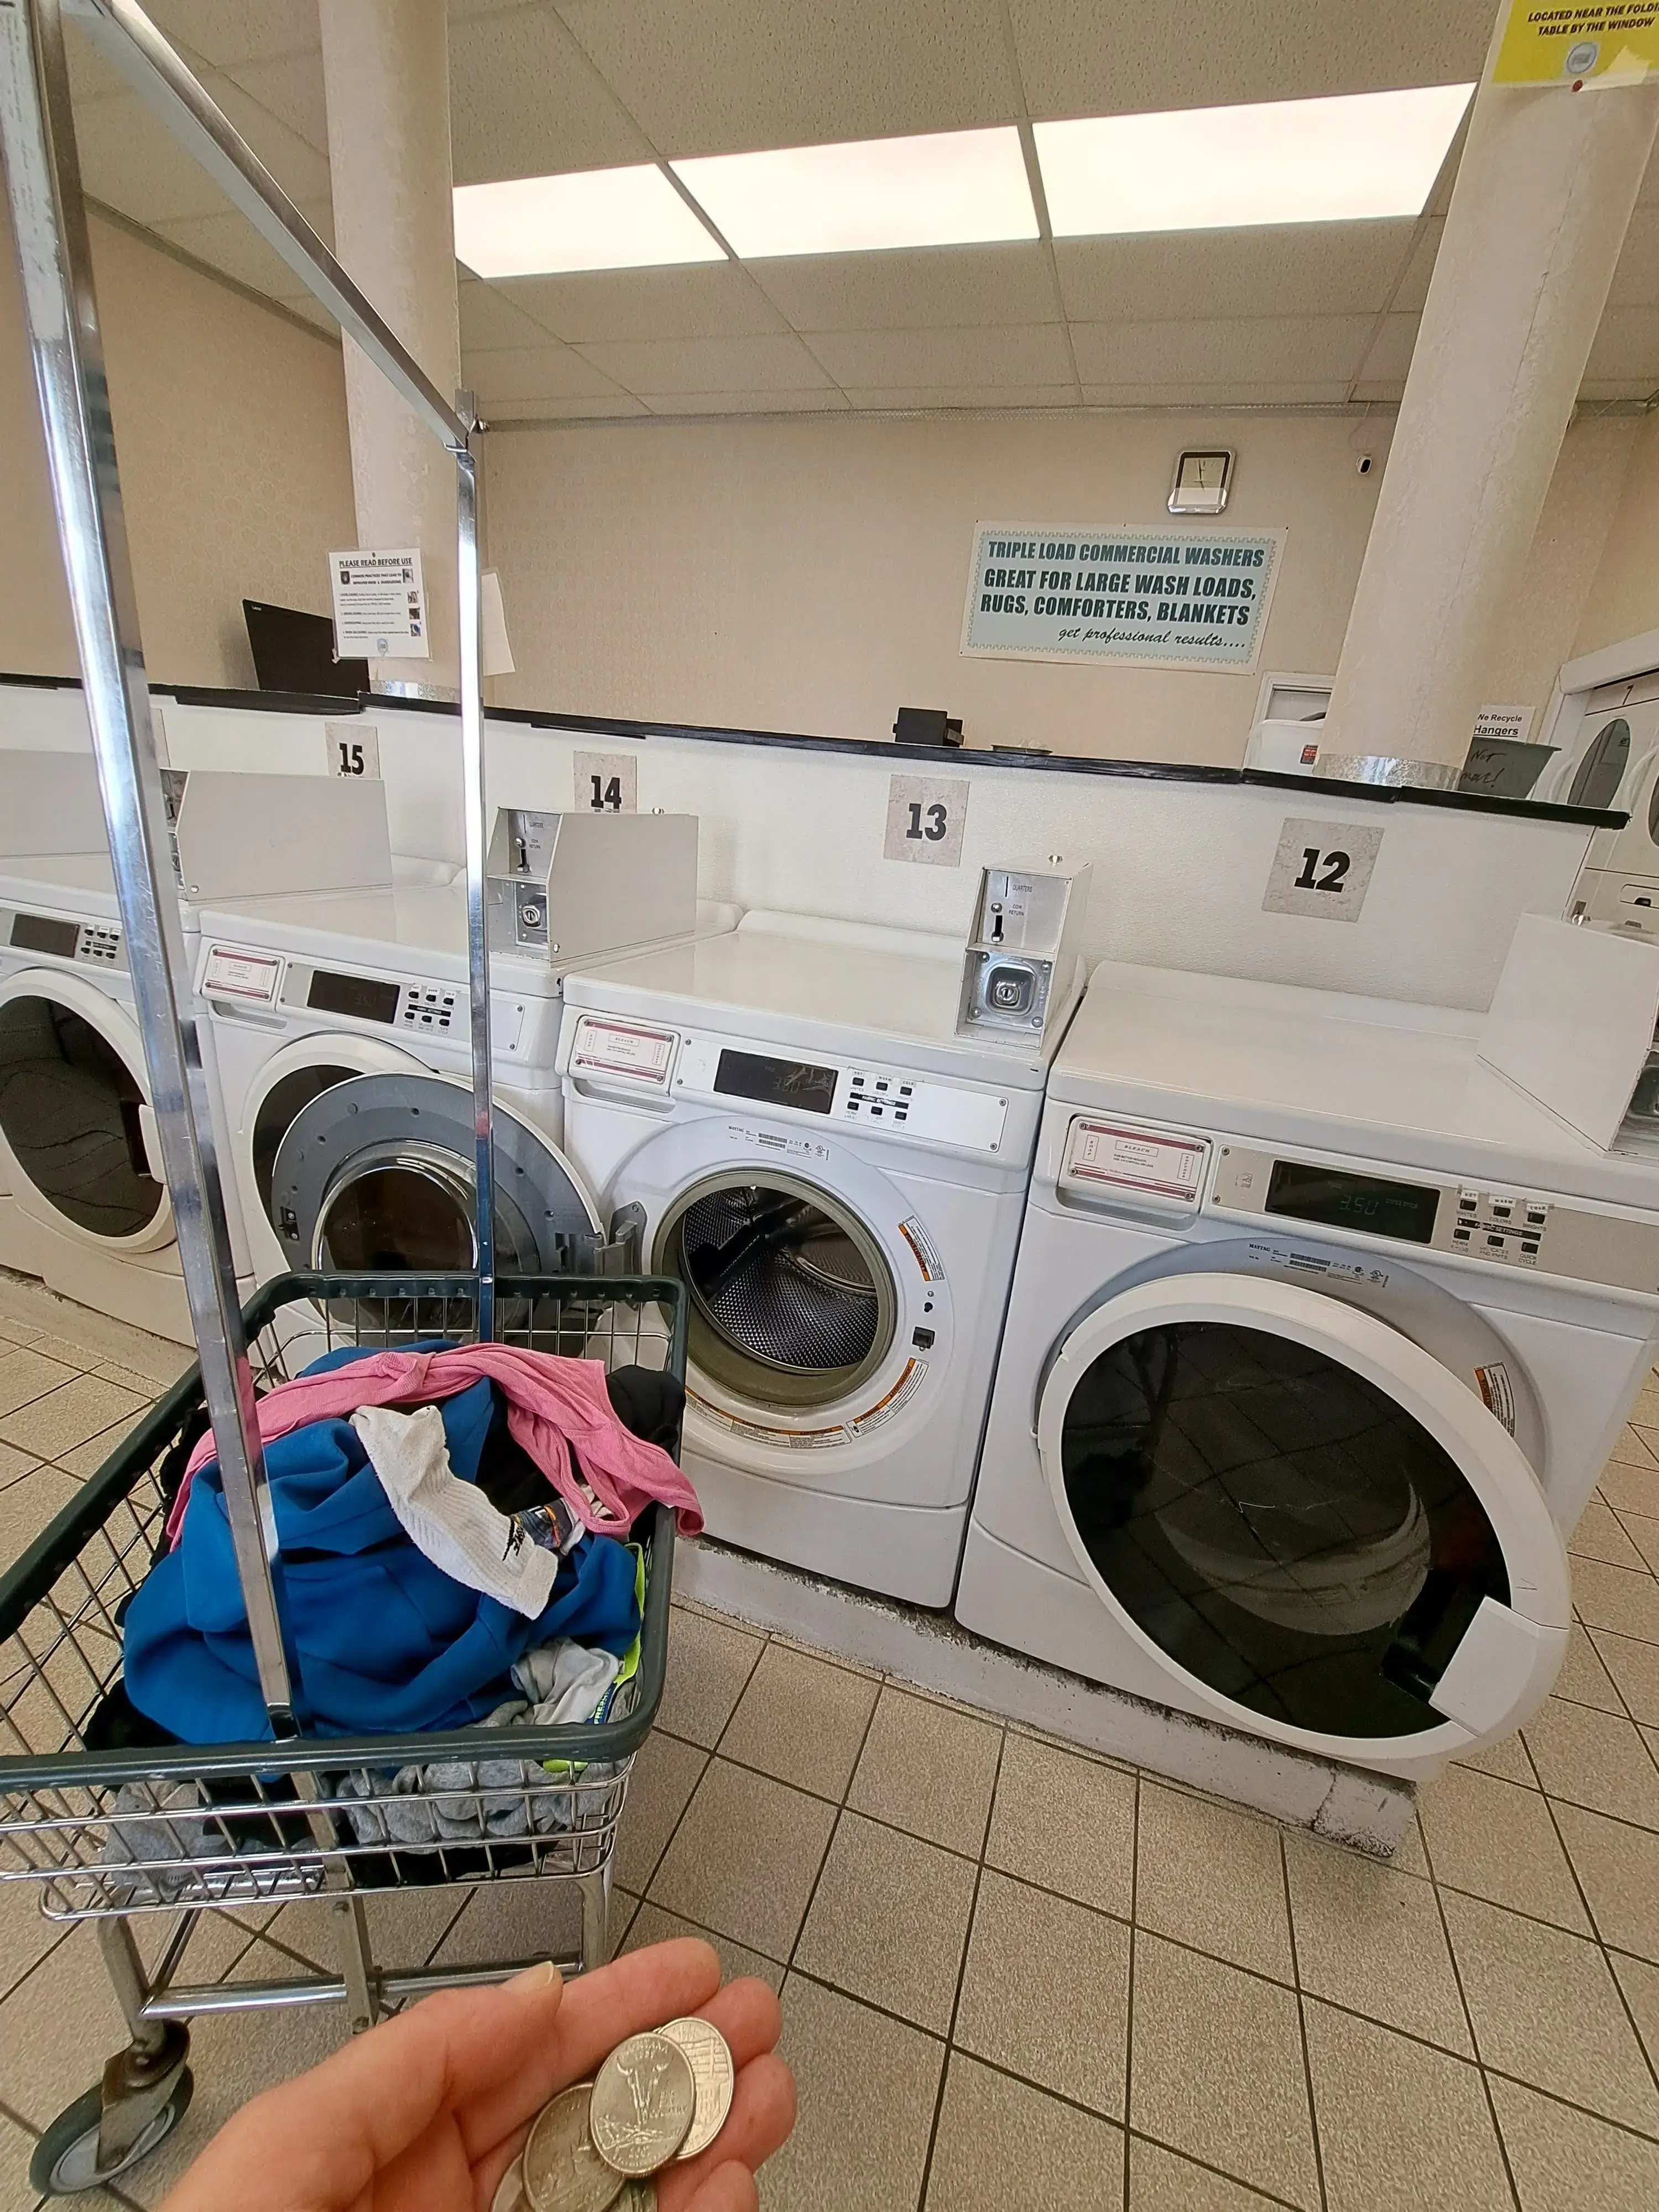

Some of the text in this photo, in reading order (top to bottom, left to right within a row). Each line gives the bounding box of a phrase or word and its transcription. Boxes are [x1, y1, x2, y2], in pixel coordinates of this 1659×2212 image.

[1527, 9, 1573, 22] LOCATED
[1575, 7, 1603, 18] NEAR
[1605, 5, 1625, 17] THE
[1538, 17, 1655, 36] TABLE BY THE WINDOW
[339, 559, 359, 567] PLEASE
[988, 541, 1265, 567] TRIPLE LOAD COMMERCIAL WASHERS
[984, 568, 1256, 601] GREAT FOR LARGE WASH LOADS,
[980, 593, 1250, 626] RUGS, COMFORTERS, BLANKETS
[1058, 627, 1082, 643] get
[1083, 626, 1171, 646] professional
[1491, 714, 1522, 723] Recycle
[1473, 725, 1519, 736] Hangers
[339, 743, 364, 775] 15
[591, 775, 622, 810] 14
[906, 803, 947, 841] 13
[1294, 848, 1350, 893] 12
[1124, 1145, 1150, 1153] BLEACH
[1339, 1194, 1379, 1215] 3.50
[1522, 1223, 1547, 1232] BRIGHTS
[1249, 1243, 1271, 1252] MAYTAG
